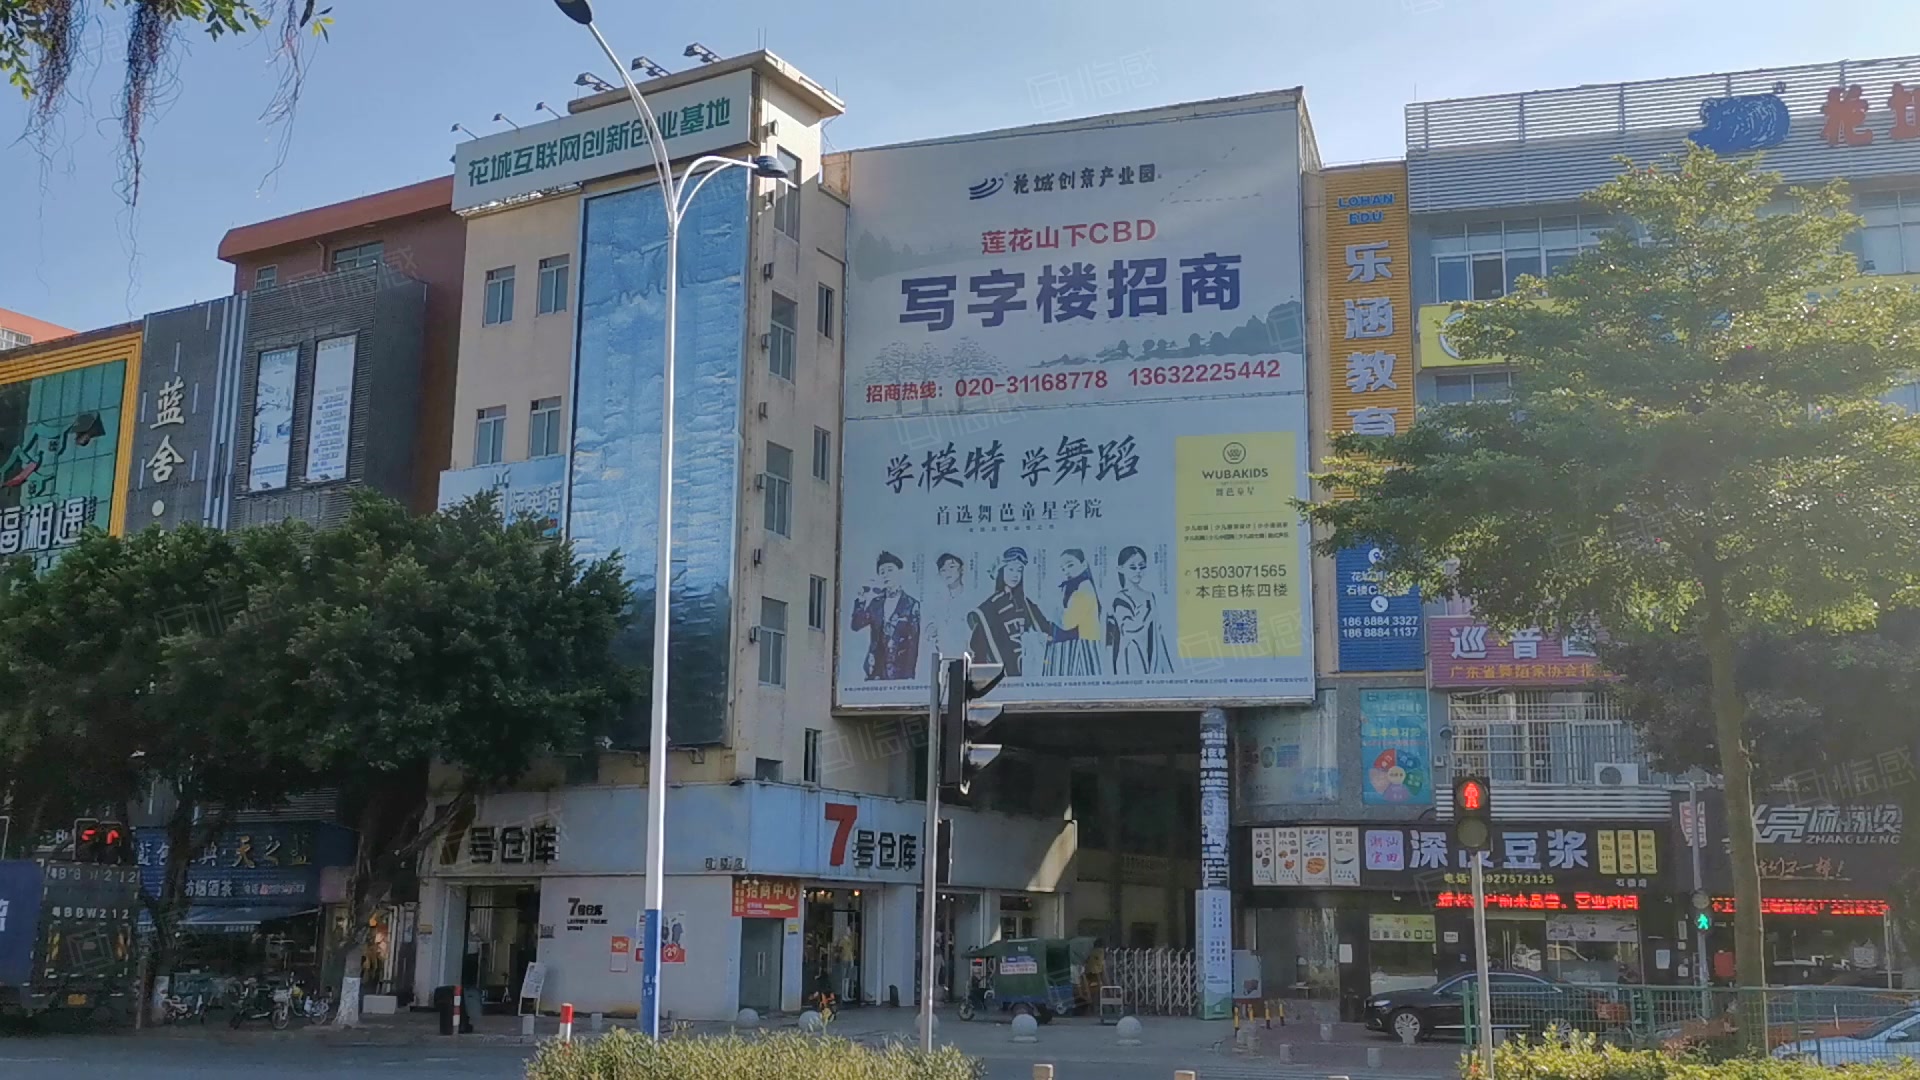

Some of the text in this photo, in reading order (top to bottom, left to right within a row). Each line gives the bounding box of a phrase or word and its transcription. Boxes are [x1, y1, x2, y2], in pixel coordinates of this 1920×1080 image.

[468, 96, 731, 187] 花城互联网创新创业基地
[1337, 193, 1394, 208] LOHAN
[1348, 211, 1384, 225] EDU
[982, 219, 1157, 255] 莲花山下CBD
[899, 252, 1243, 332] 写字楼招商
[1344, 240, 1398, 437] 乐涵教育
[954, 369, 1108, 397] 020-31168778
[1128, 360, 1281, 386] 13632225442
[146, 376, 185, 483] 蓝舍
[885, 434, 1140, 493] 学模特 学舞蹈
[1202, 468, 1269, 480] WUBAKIDS
[936, 498, 1103, 526] 首选舞芭童星学院
[1194, 564, 1287, 580] 13503071565
[1195, 582, 1288, 599] 本座B栋四楼
[1342, 615, 1419, 627] 186 8884 3327
[1342, 627, 1419, 639] 186 8884 1137
[824, 802, 917, 872] 7号仓库
[746, 880, 797, 900] 招商中心
